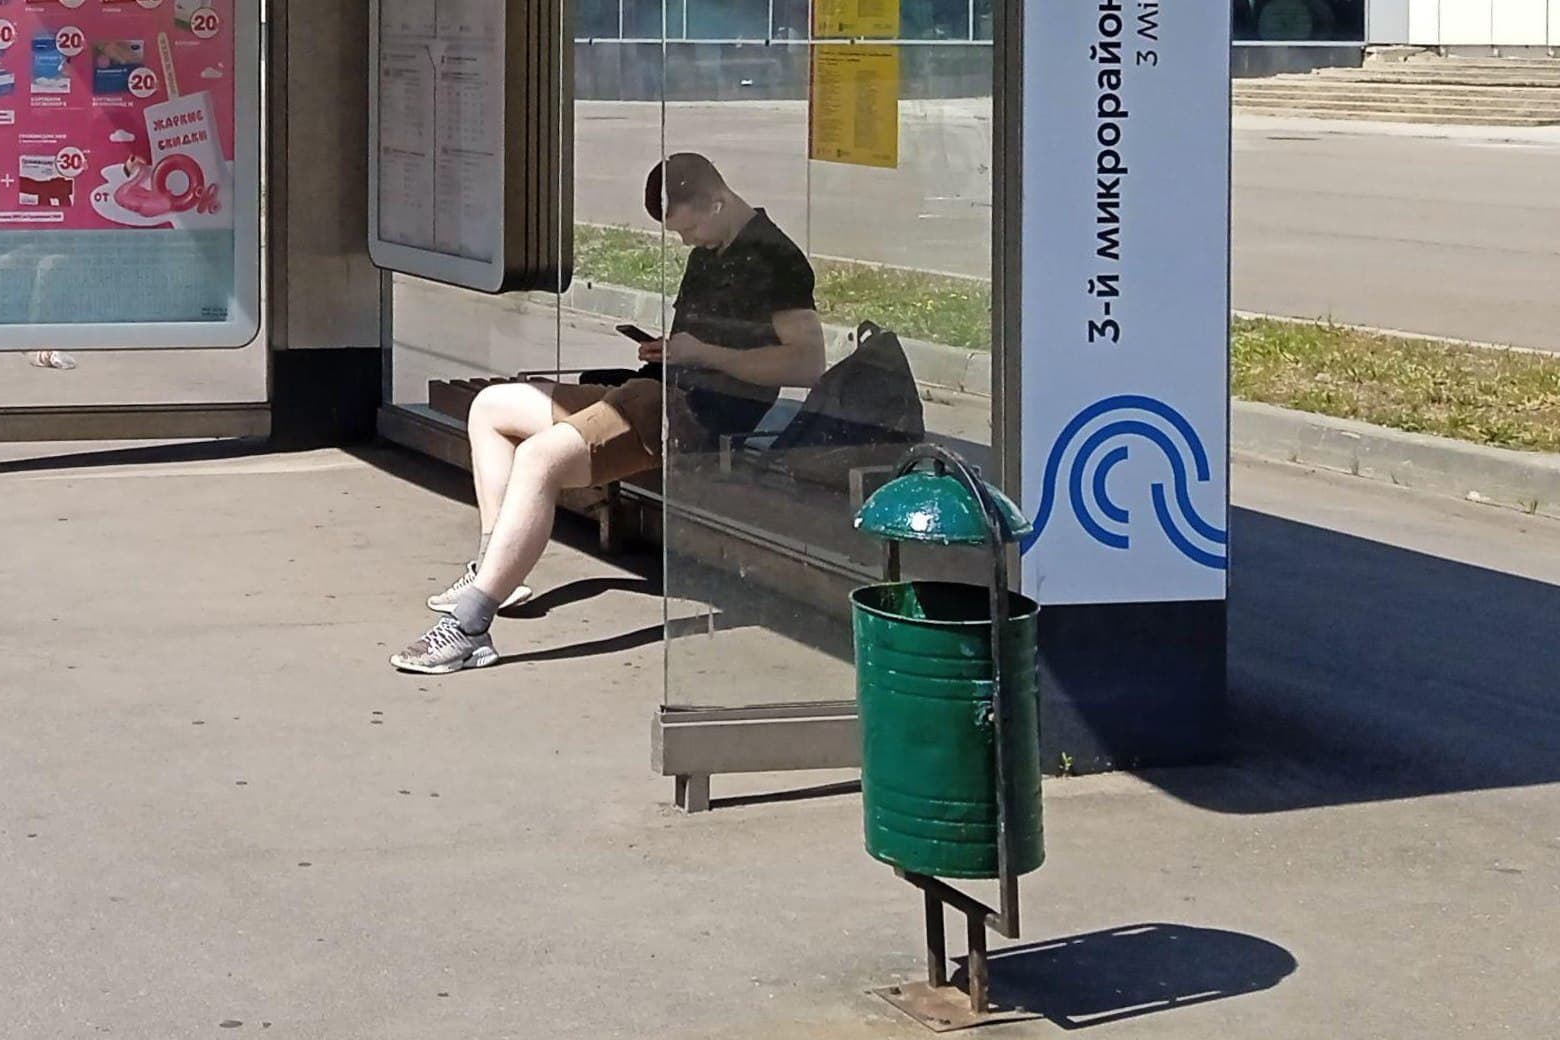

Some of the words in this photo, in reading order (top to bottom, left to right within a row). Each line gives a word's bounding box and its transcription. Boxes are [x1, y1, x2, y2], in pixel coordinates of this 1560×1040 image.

[1136, 49, 1158, 67] 3
[158, 131, 208, 151] СКИДКИ
[1089, 273, 1121, 344] 3-й
